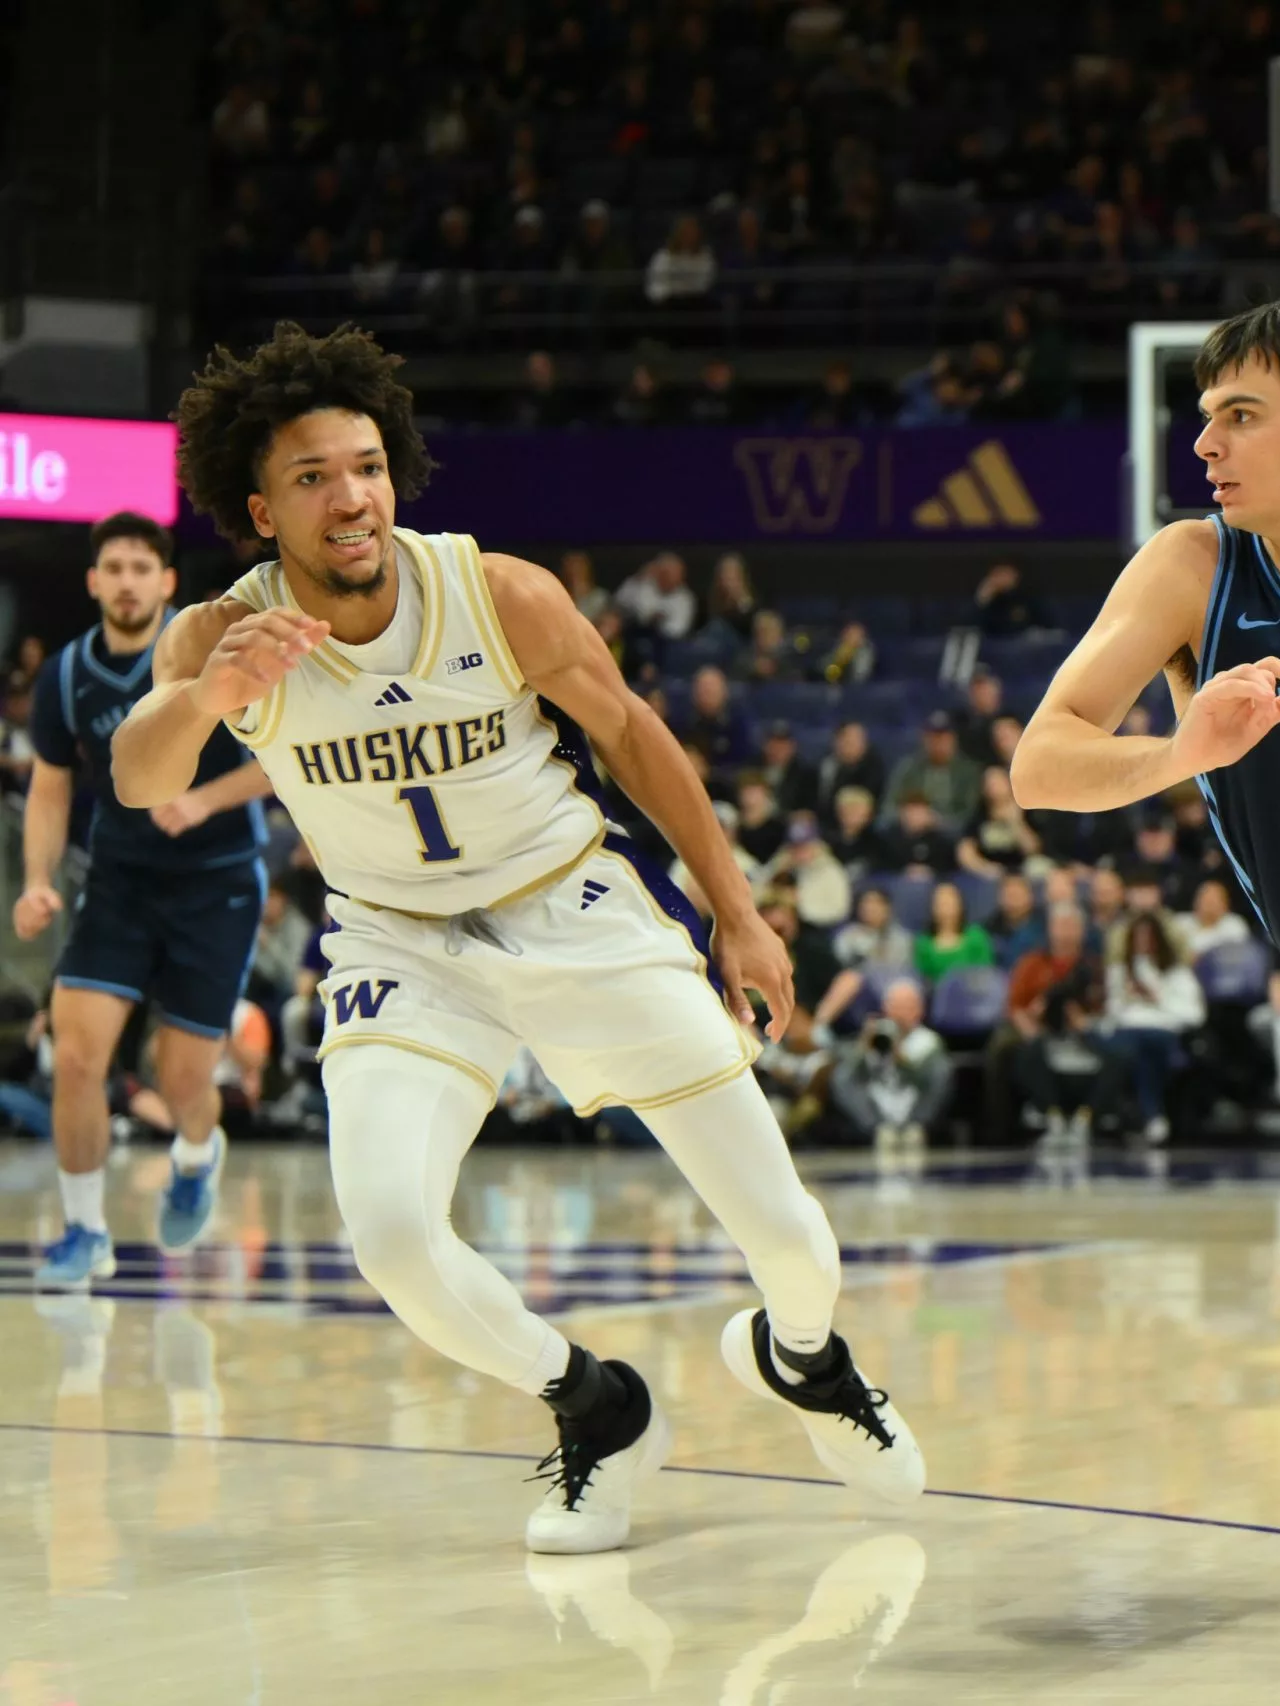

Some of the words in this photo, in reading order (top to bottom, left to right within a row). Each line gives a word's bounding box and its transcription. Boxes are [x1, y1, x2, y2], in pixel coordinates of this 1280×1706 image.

[290, 707, 508, 786] HUSKIES
[395, 784, 465, 865] 1
[331, 978, 400, 1027] W
